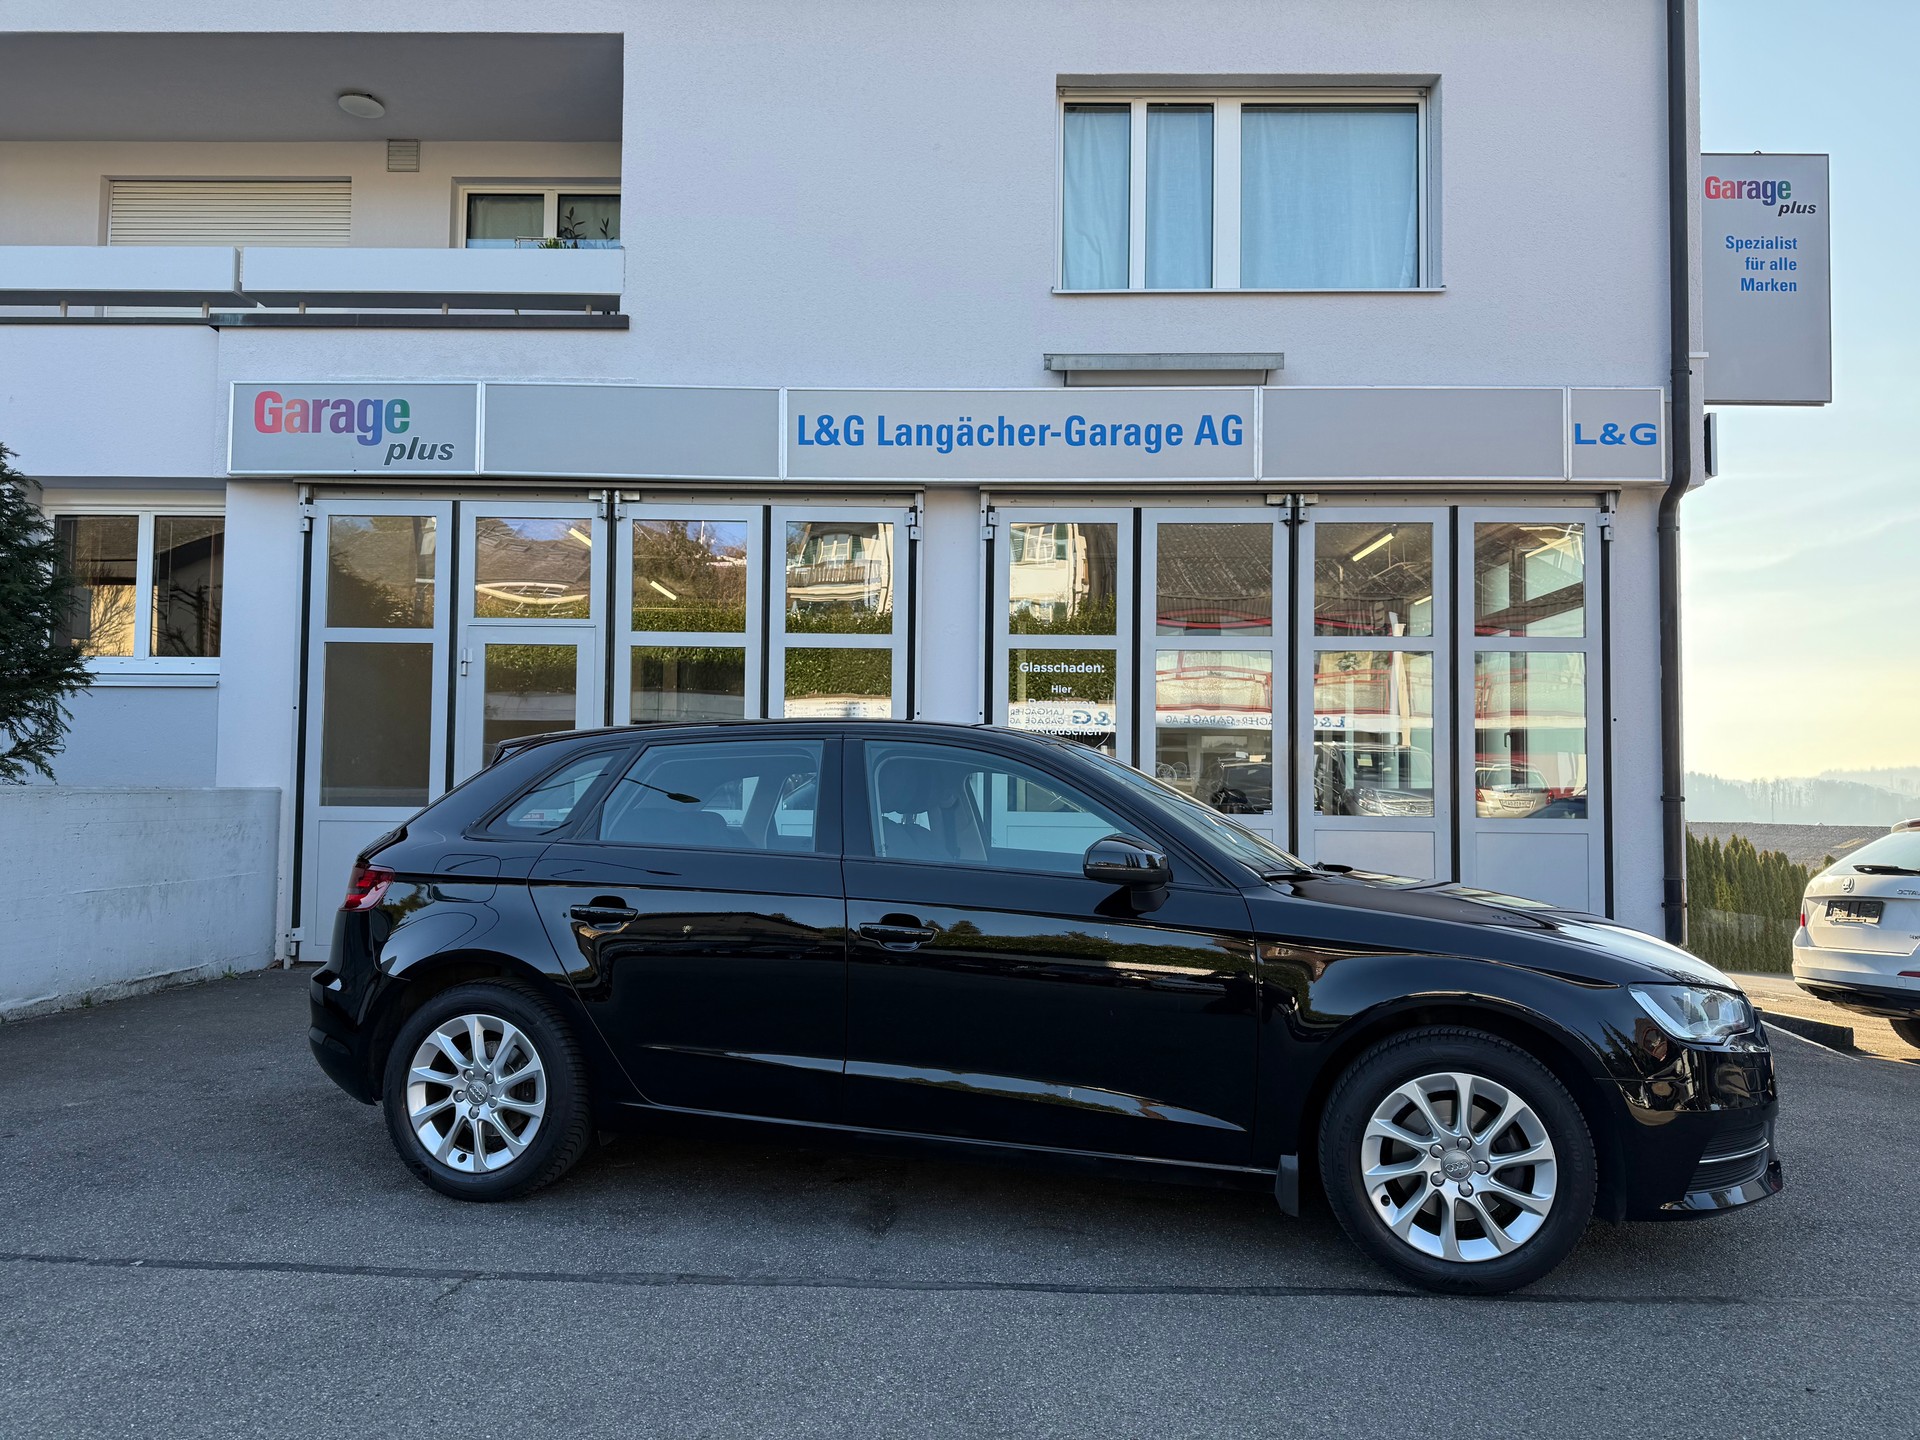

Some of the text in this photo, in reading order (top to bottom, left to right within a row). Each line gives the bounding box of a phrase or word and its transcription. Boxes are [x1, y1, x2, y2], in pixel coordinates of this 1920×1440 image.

[1704, 175, 1792, 207] Garage
[1777, 200, 1817, 217] plus
[1725, 235, 1798, 252] Spezialist
[1745, 256, 1797, 271] für alle
[1740, 277, 1797, 292] Marken
[254, 390, 411, 446] Garage
[797, 413, 1244, 454] L&G Langächer-Garage AG
[1574, 422, 1657, 446] L&G
[383, 436, 455, 466] plus
[1019, 661, 1105, 674] Glasschaden:
[1051, 684, 1073, 694] Hier
